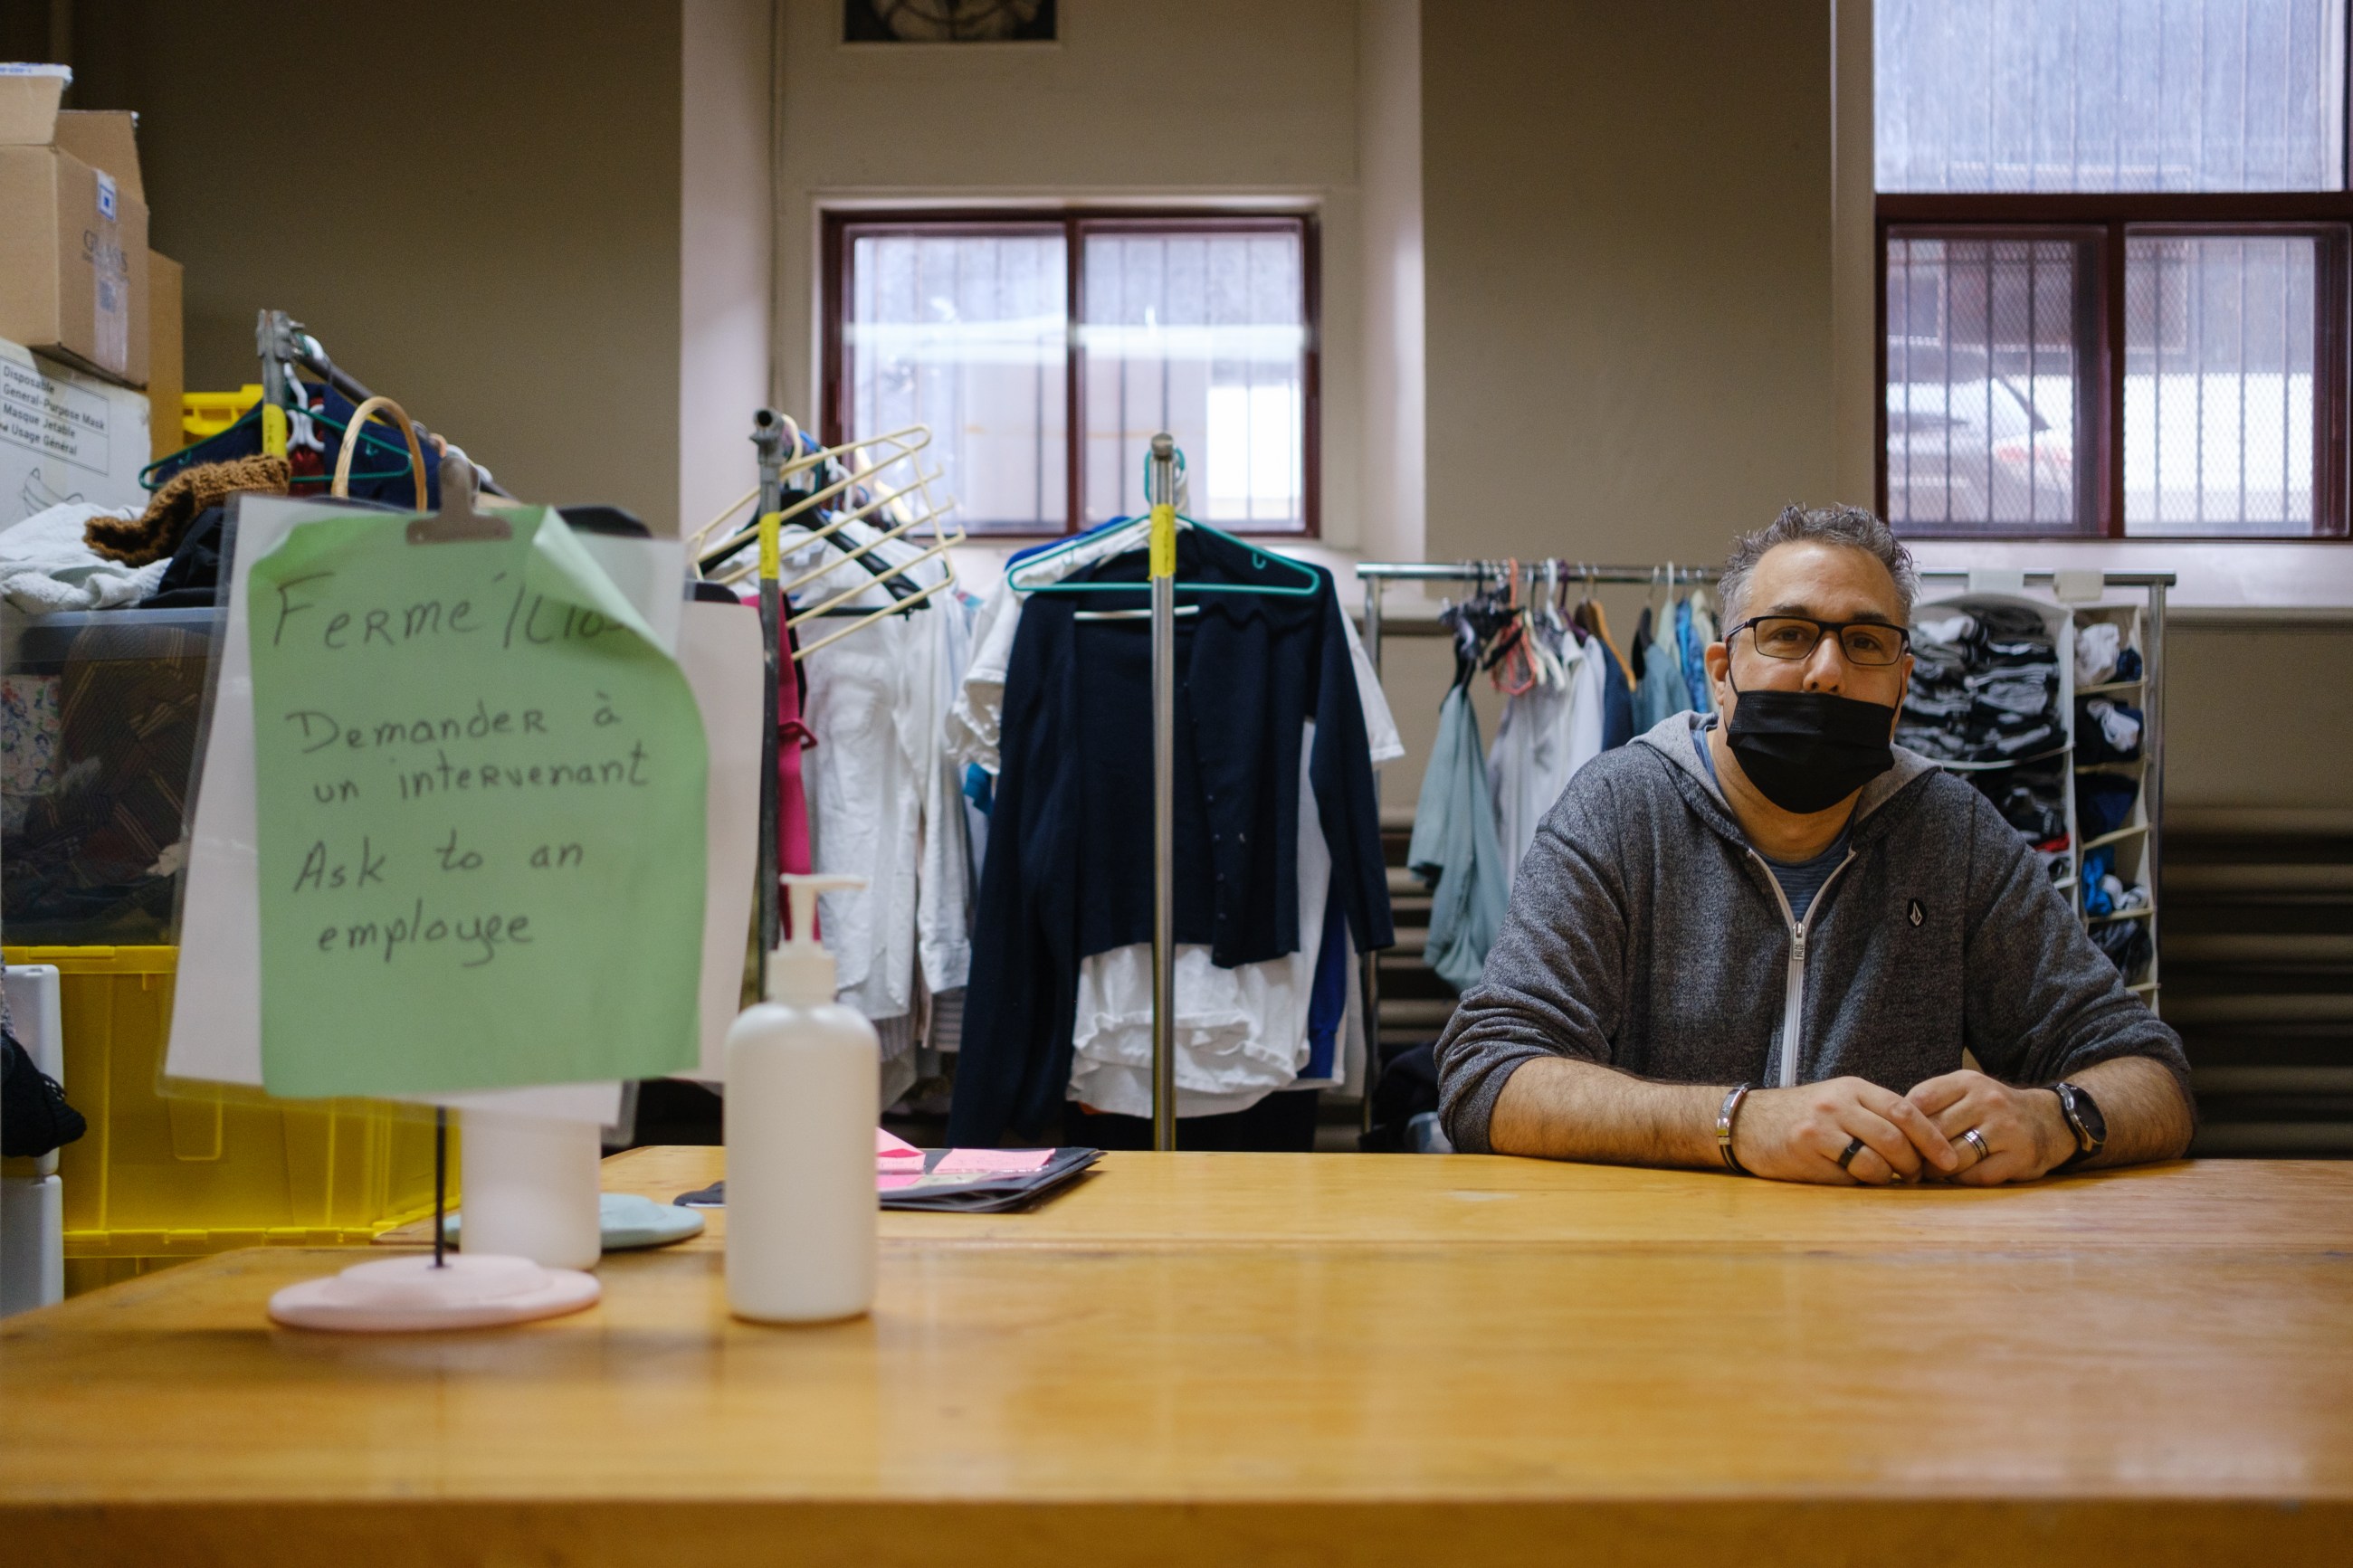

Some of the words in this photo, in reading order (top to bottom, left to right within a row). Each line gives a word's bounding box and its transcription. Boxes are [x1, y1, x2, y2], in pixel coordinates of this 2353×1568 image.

[4, 366, 54, 394] Disposable
[4, 404, 40, 424] Masque
[43, 418, 75, 438] Jetable
[12, 423, 41, 443] Usage
[82, 413, 104, 430] Mask
[594, 690, 622, 727] à
[314, 778, 360, 803] un
[294, 836, 386, 892] Ask
[435, 828, 484, 871] to
[530, 841, 584, 869] an
[318, 898, 536, 968] employee
